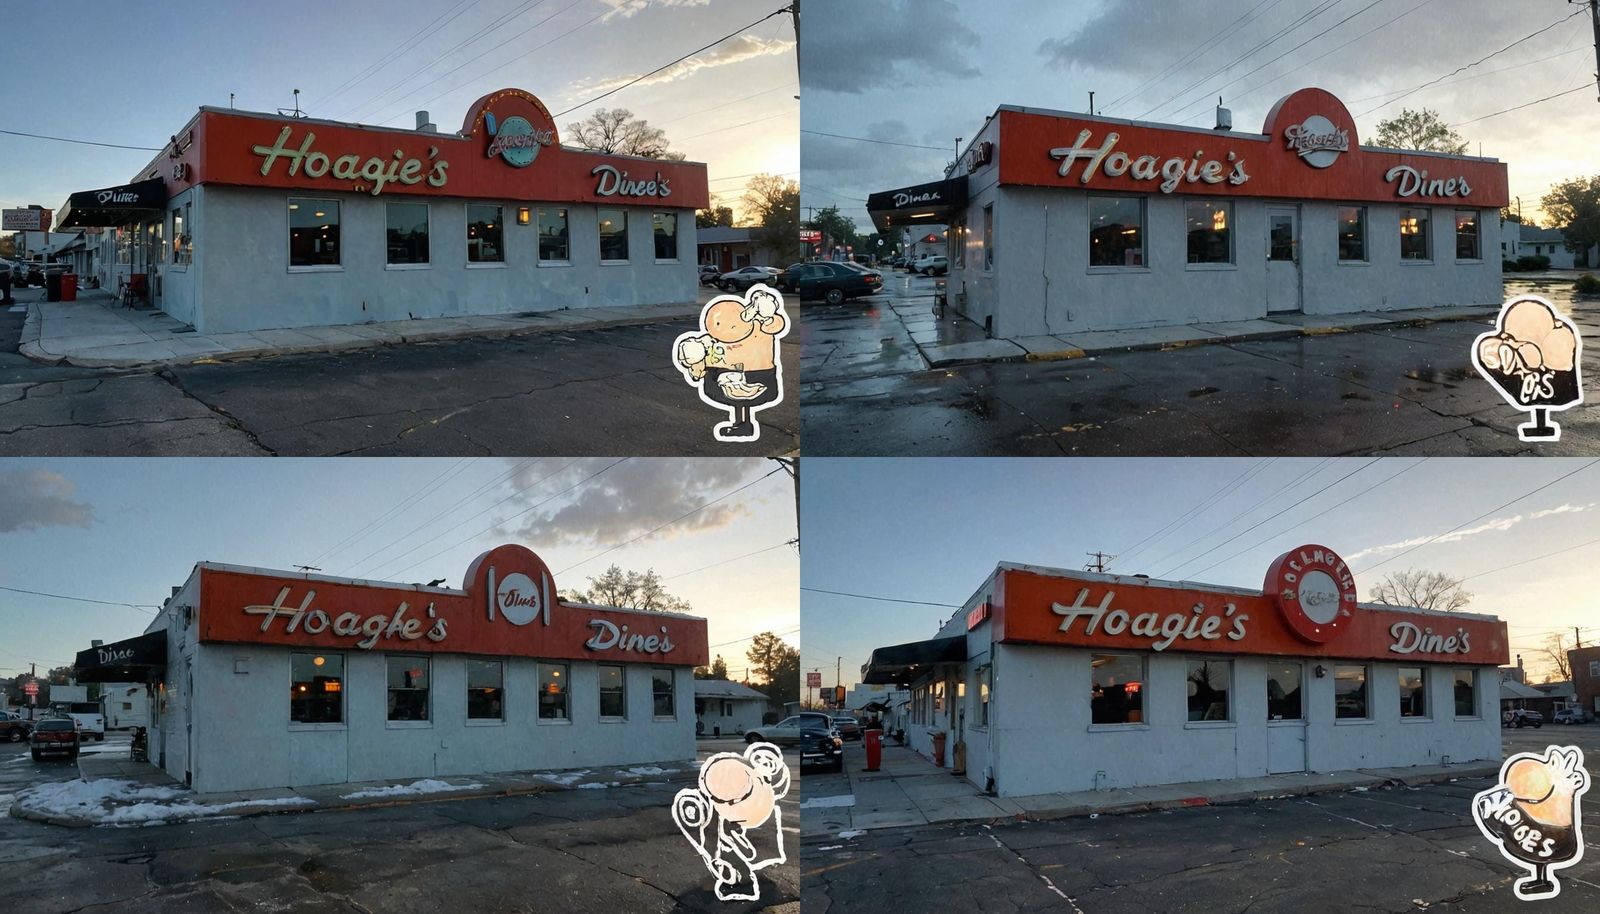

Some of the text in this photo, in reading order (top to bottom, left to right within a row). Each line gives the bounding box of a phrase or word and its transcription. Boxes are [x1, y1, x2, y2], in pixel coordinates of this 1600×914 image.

[253, 126, 448, 196] Hoagie's
[1050, 128, 1251, 194] Hoagie's
[1051, 587, 1249, 651] Hoagie's
[1389, 621, 1470, 654] Dine's
